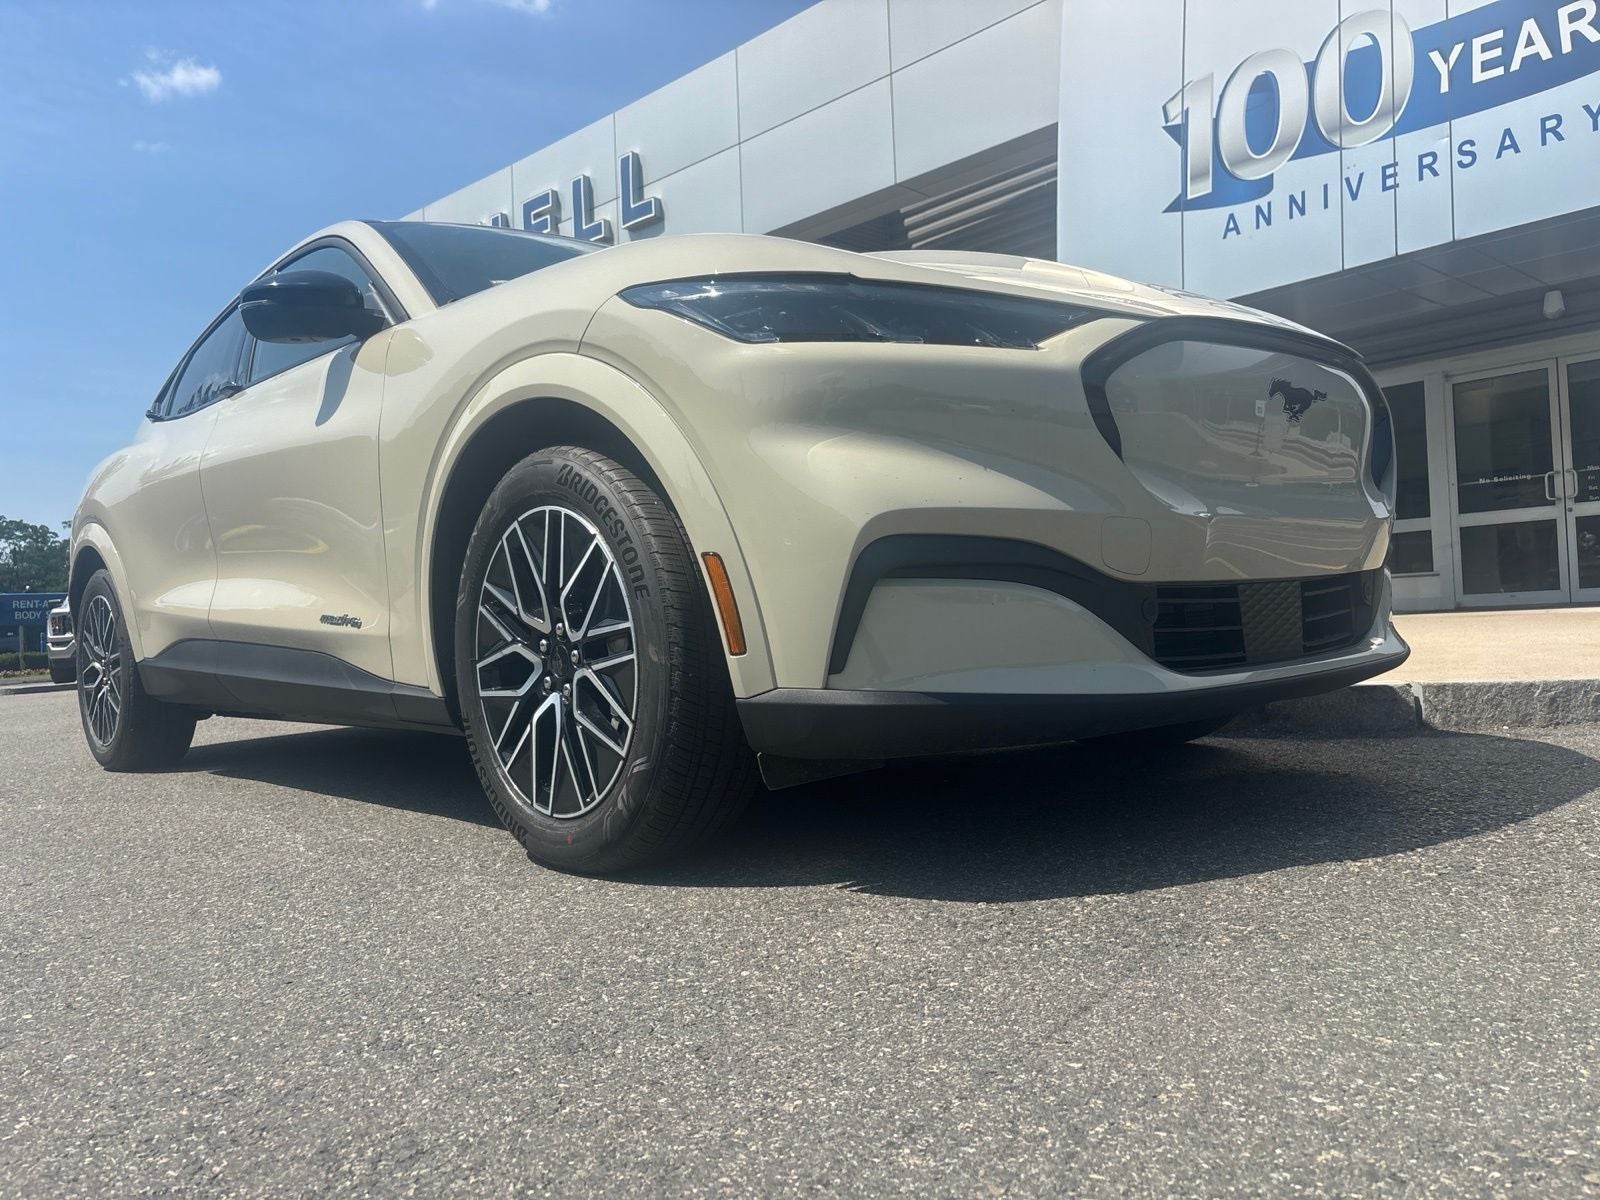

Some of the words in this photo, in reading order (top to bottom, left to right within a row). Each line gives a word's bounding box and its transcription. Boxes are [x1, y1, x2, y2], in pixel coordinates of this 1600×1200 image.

[1163, 9, 1415, 200] 100
[1222, 102, 1600, 240] ANNIVERSARY
[490, 150, 665, 241] ELL
[555, 462, 651, 601] BRIDGESTONE
[14, 611, 42, 620] BODY
